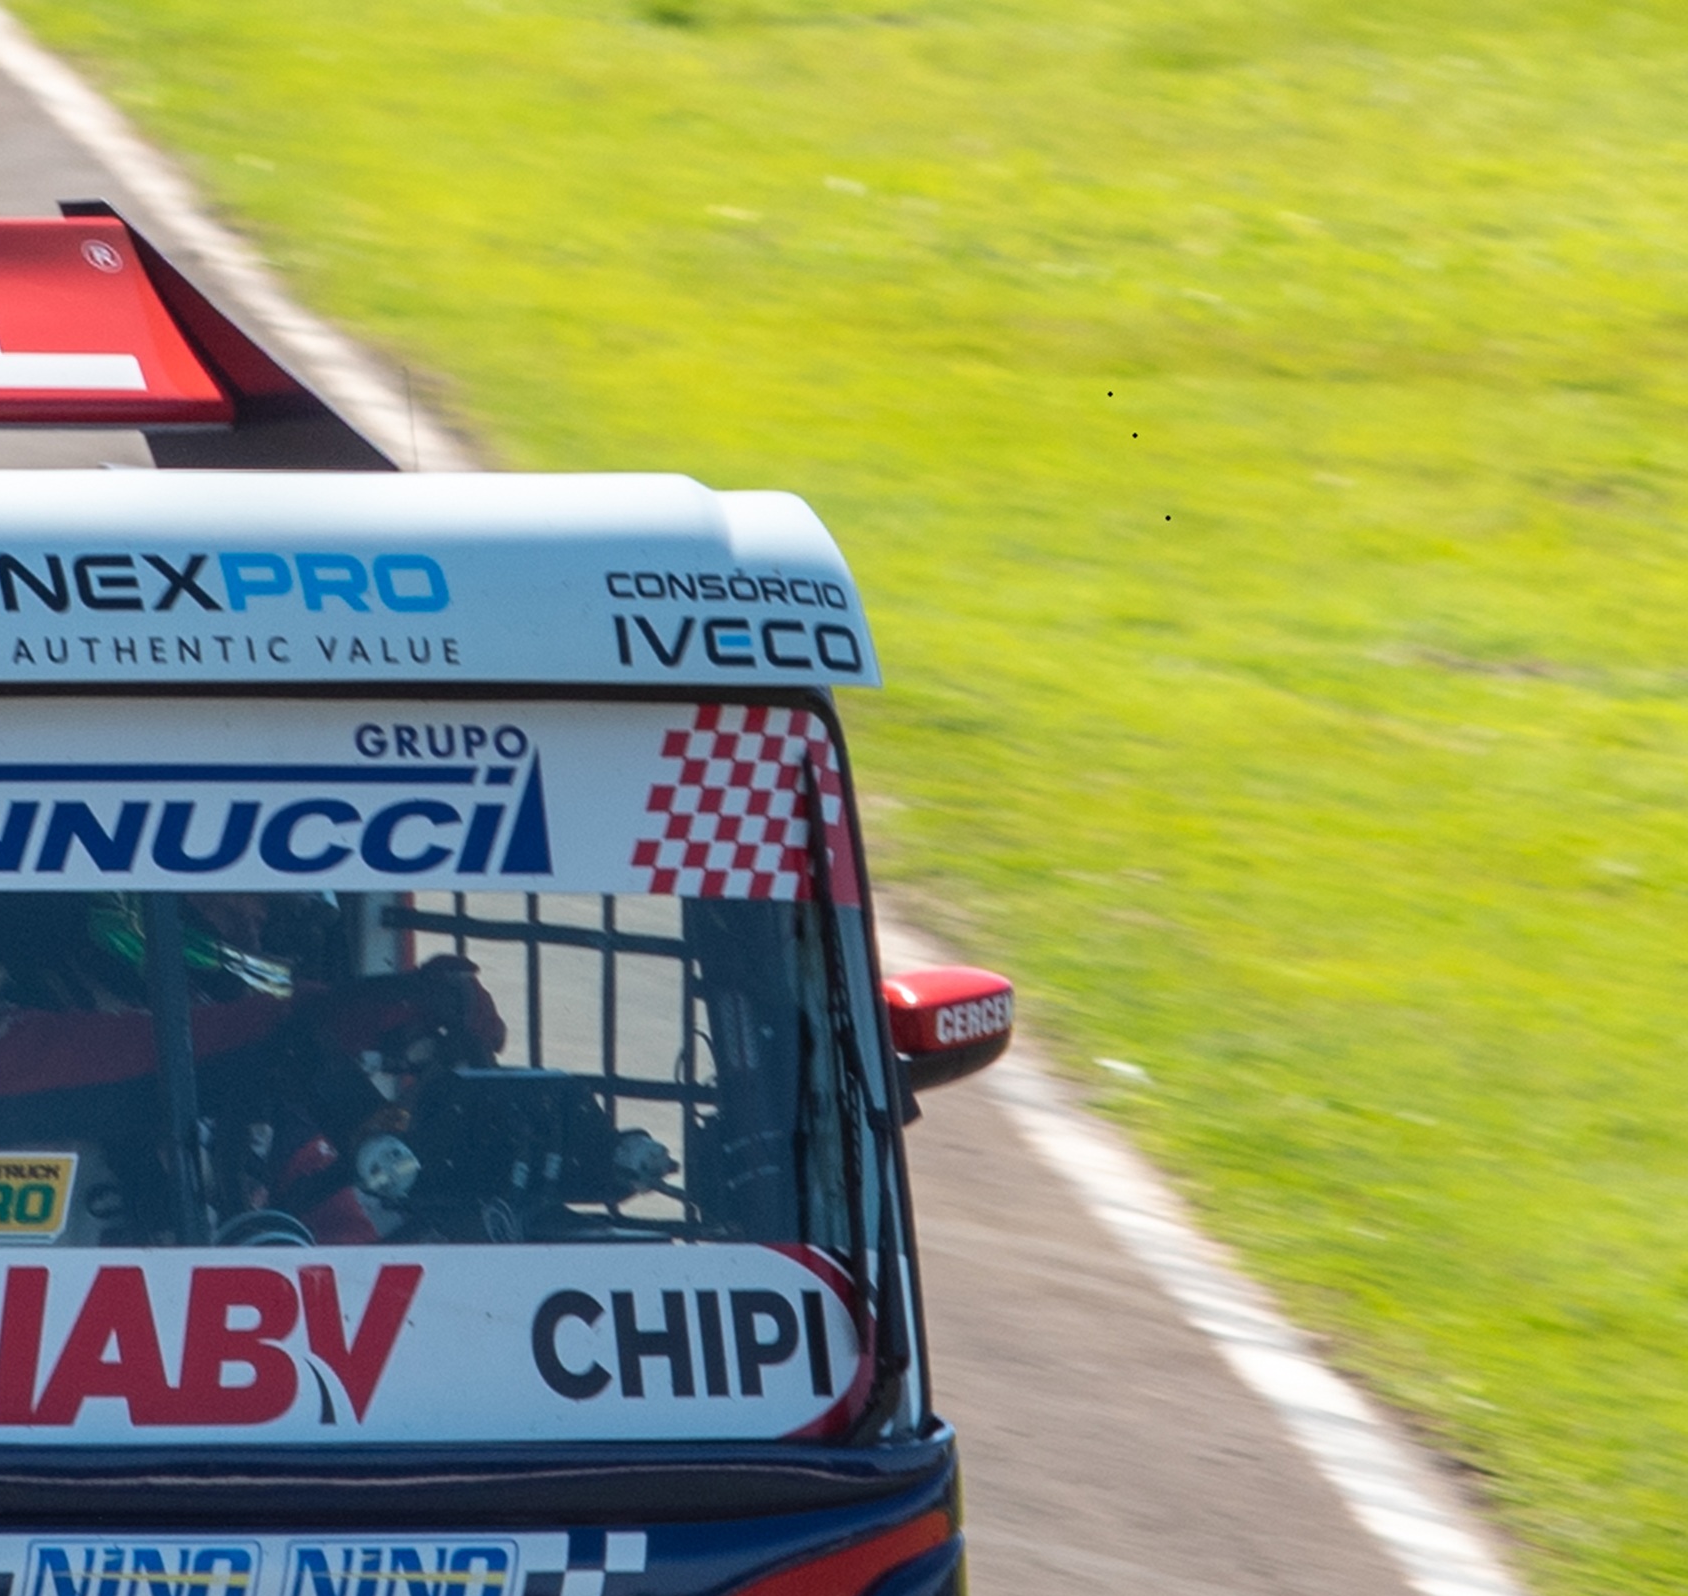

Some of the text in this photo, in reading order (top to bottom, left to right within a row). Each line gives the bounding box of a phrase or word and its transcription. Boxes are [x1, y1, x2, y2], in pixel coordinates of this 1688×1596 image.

[606, 568, 847, 611] CONSÓRCIO
[12, 636, 463, 667] AUTHENTIC VALUE
[612, 614, 864, 674] IVECO
[353, 722, 530, 760] GRUPO
[530, 1288, 835, 1402] CHIPI
